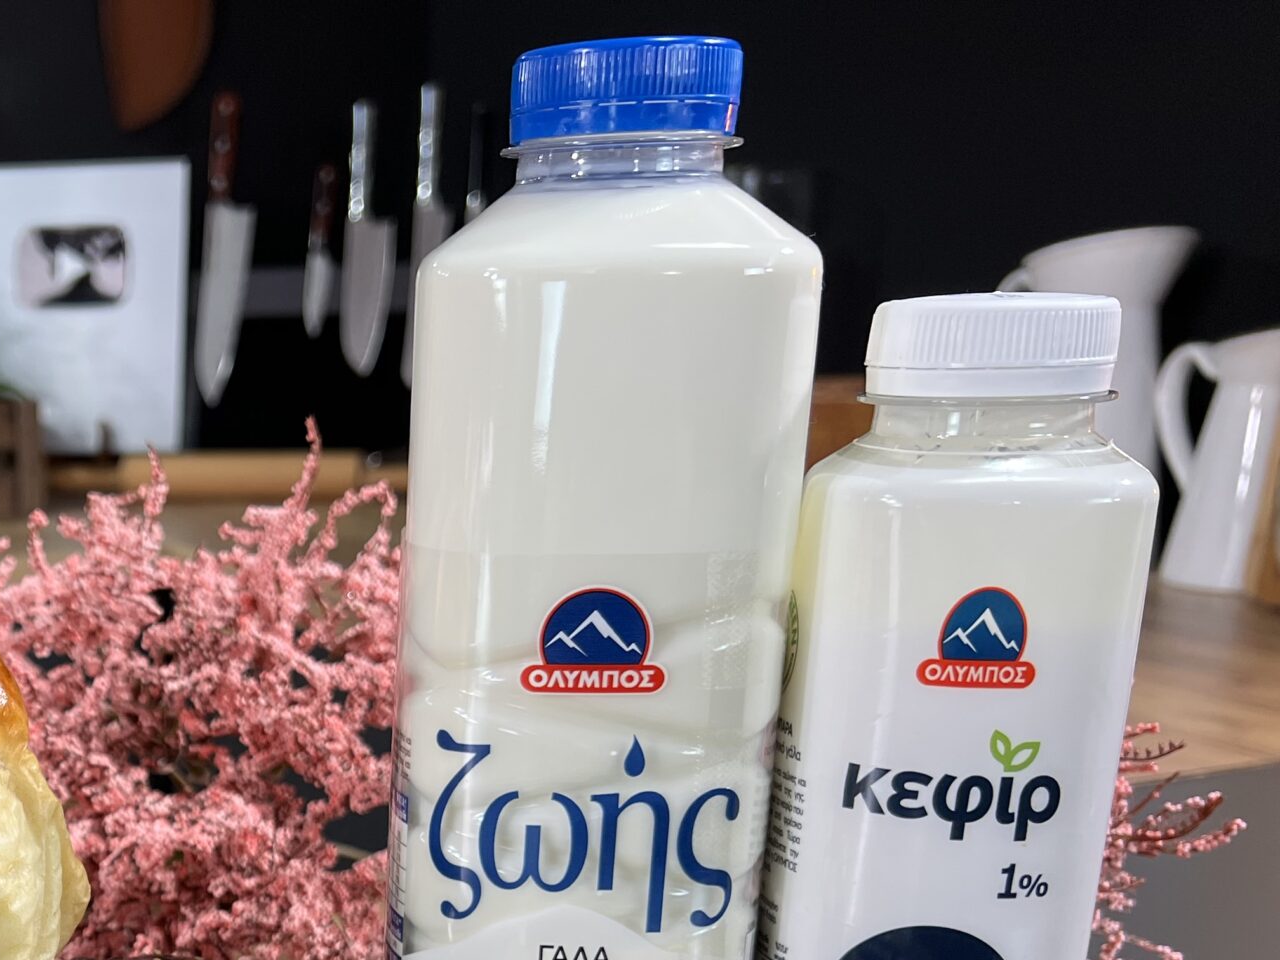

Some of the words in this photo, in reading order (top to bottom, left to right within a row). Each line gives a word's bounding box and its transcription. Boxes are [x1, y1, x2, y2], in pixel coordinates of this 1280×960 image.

[527, 668, 656, 689] ΟΛΥΜΠΟΣ
[924, 663, 1027, 684] ΟΛΥΜΠΟΣ
[428, 729, 741, 933] ζωής
[996, 863, 1049, 899] 1%
